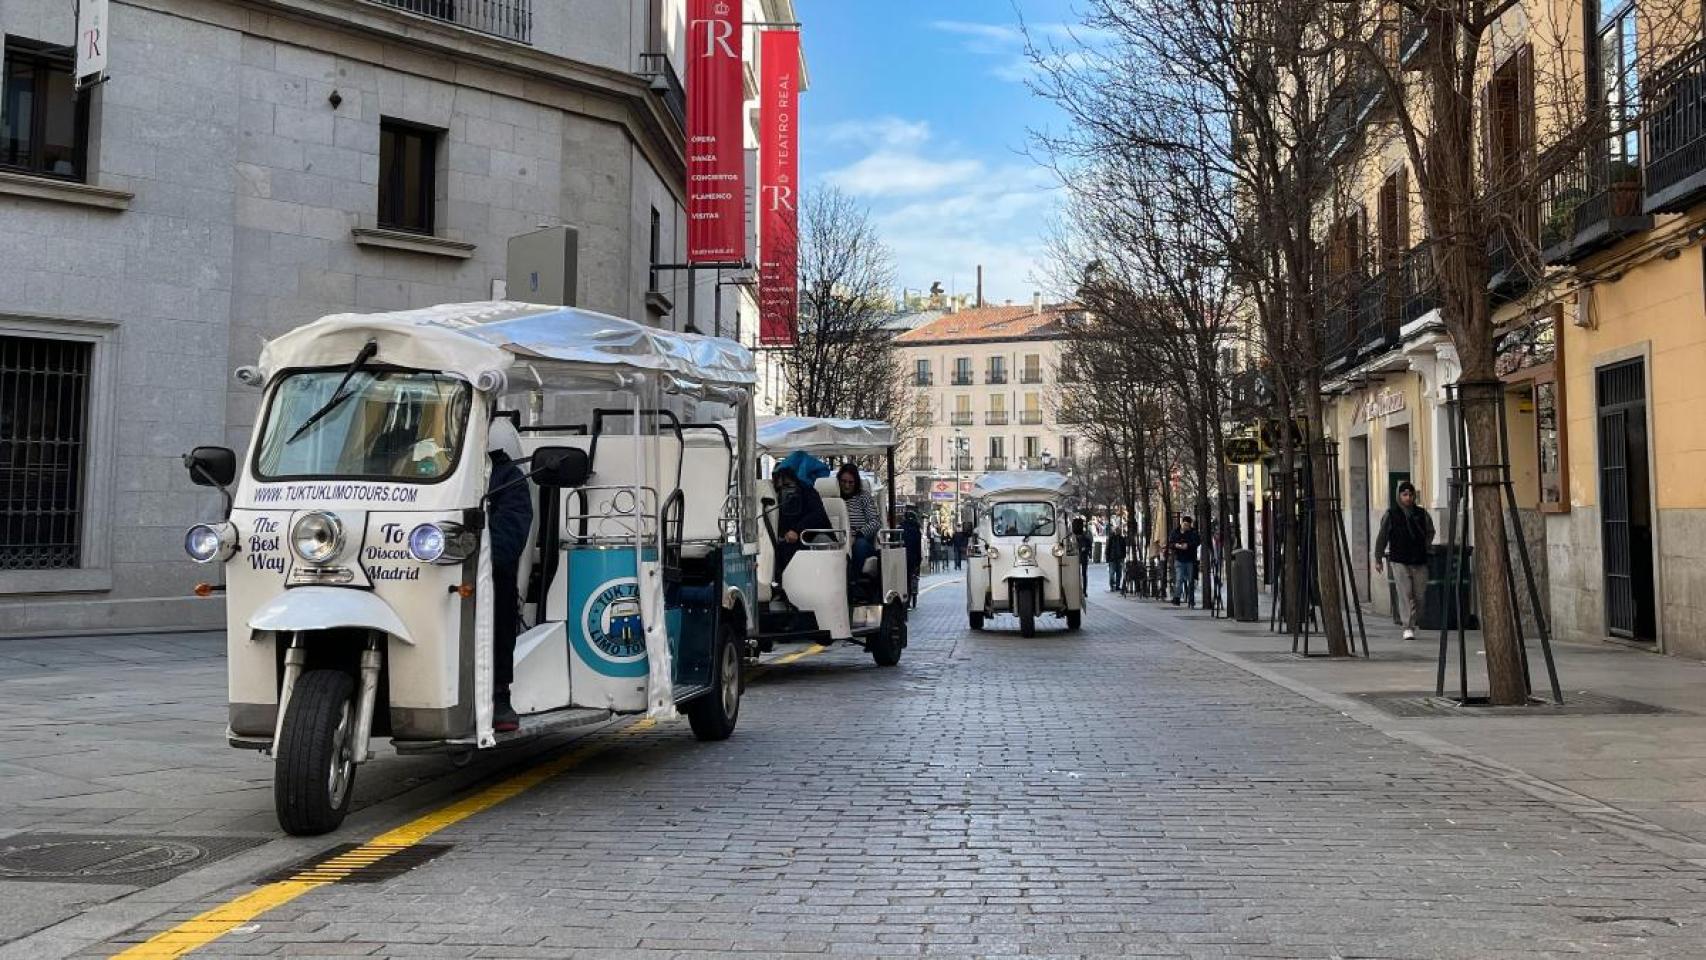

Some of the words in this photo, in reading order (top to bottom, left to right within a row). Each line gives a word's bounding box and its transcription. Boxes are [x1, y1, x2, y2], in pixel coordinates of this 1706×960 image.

[778, 73, 790, 108] REAL
[778, 113, 789, 167] TEATRO
[253, 517, 279, 533] The
[380, 523, 405, 543] To
[248, 535, 280, 552] Best
[246, 553, 286, 574] Way
[367, 565, 420, 580] Madrid
[597, 584, 623, 606] TUK
[589, 630, 621, 655] LIMO
